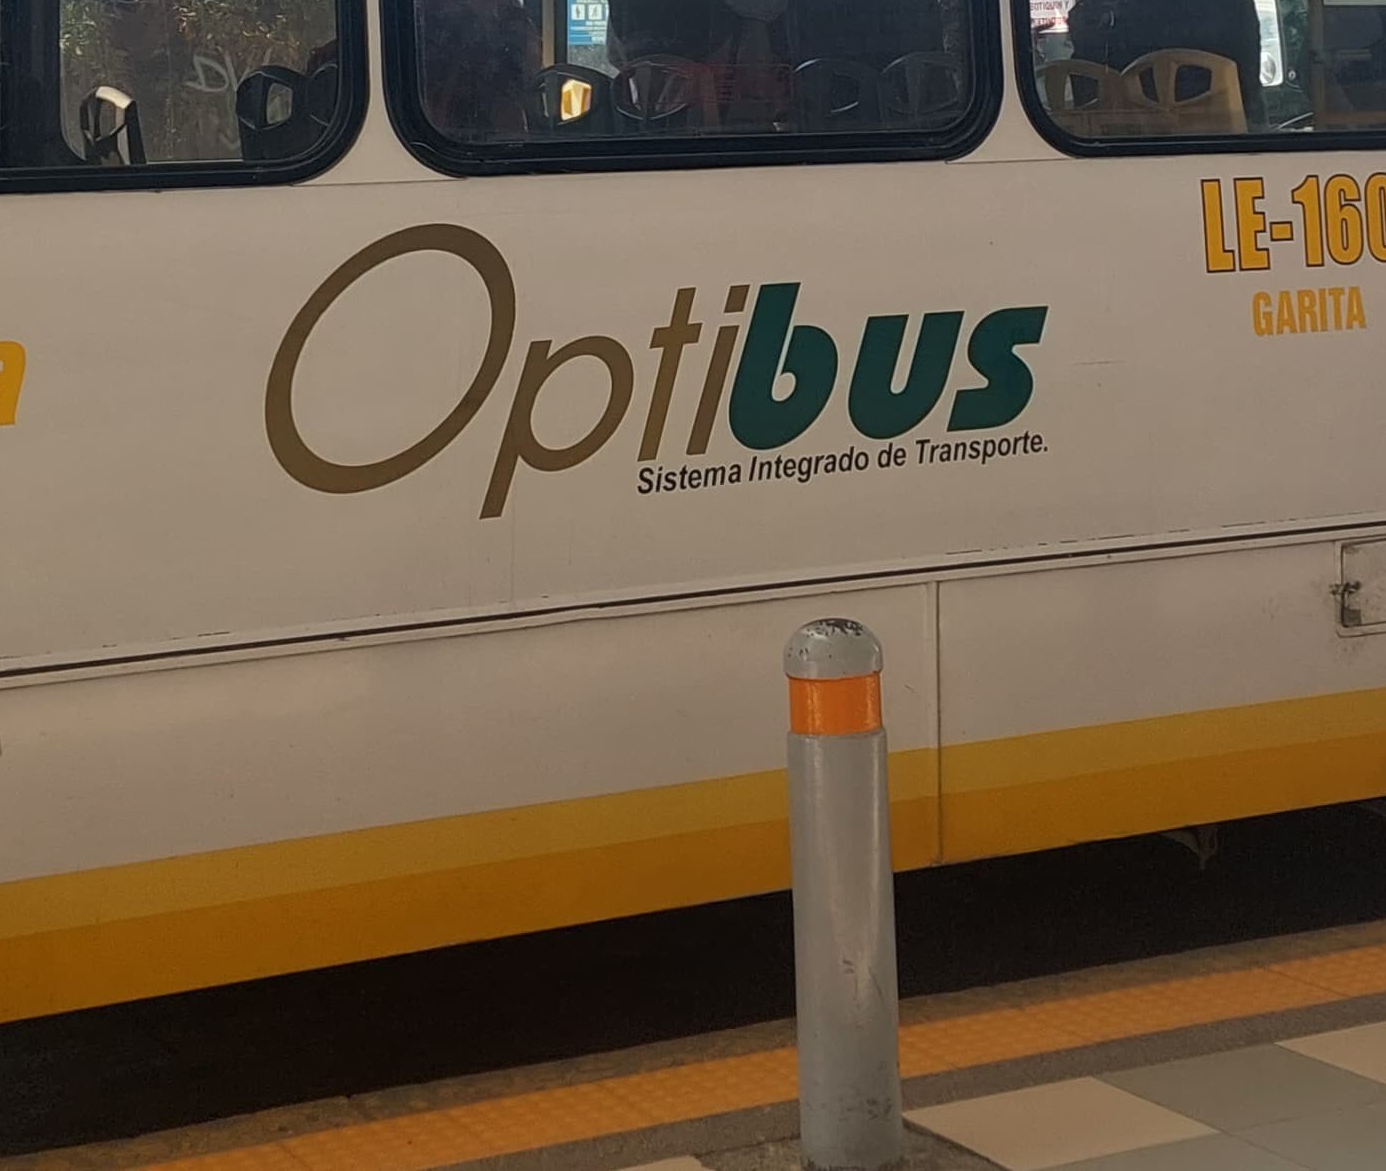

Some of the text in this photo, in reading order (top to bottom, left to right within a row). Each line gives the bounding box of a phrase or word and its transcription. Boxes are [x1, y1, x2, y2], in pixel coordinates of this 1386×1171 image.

[1252, 285, 1367, 337] GARITA
[265, 223, 1049, 520] Optibus
[637, 430, 1049, 495] Sistema Integrado de Transporte.
